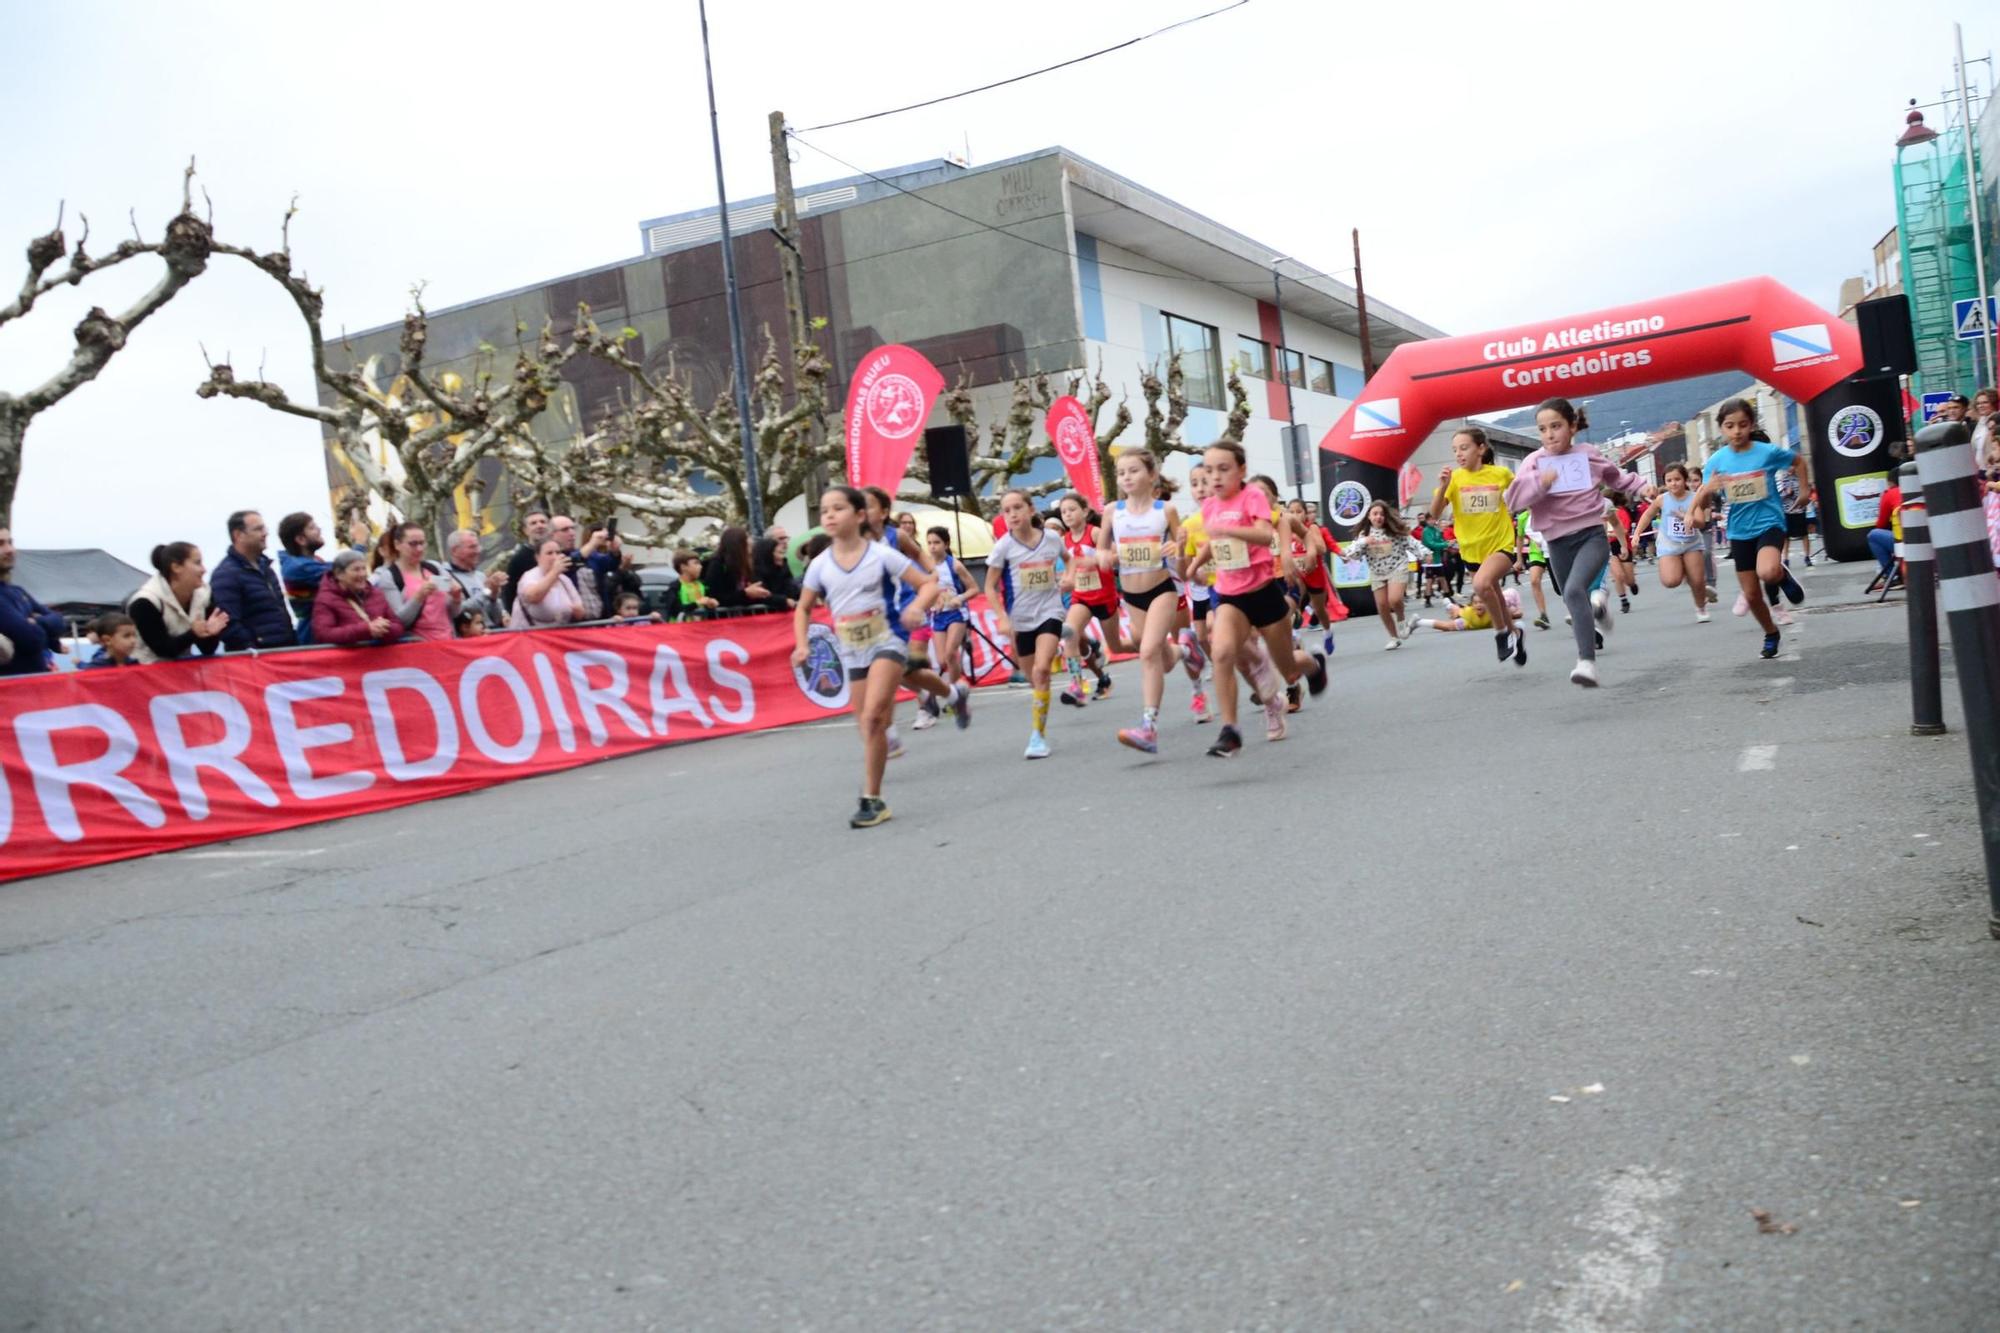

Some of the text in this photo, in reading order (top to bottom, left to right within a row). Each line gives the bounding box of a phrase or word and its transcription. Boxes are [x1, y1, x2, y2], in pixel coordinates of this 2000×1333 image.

[1483, 315, 1665, 360] Club Atletismo
[1502, 349, 1653, 388] Corredoiras
[1470, 494, 1488, 508] 291
[1127, 547, 1151, 562] 300
[1028, 570, 1050, 585] 293
[0, 637, 757, 846] RREDOIRAS
